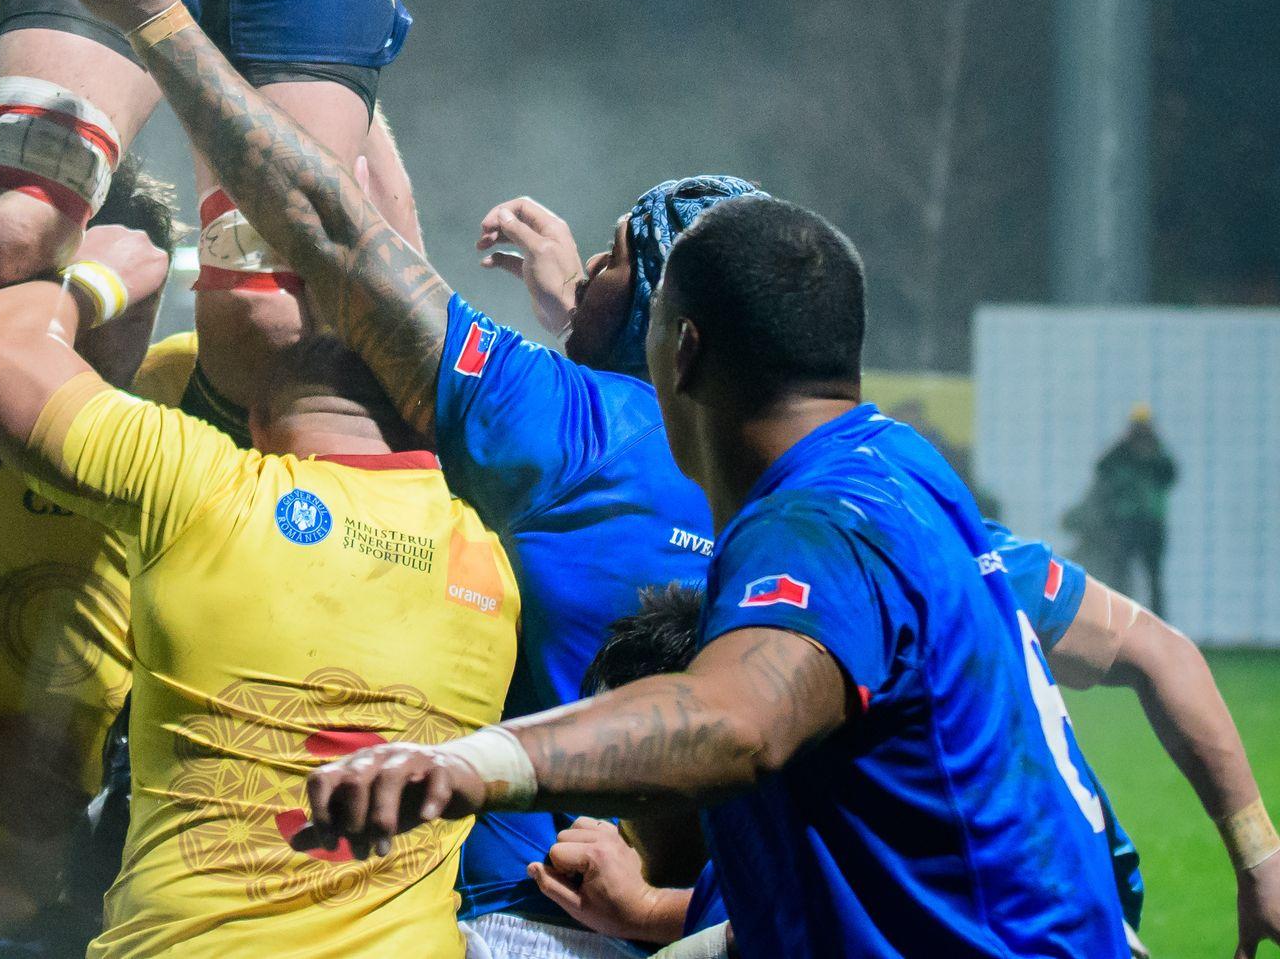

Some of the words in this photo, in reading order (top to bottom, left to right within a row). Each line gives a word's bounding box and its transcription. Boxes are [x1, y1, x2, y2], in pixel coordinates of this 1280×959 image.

[344, 516, 435, 550] MINISTERUL
[669, 527, 715, 557] INVE
[359, 543, 432, 574] SPORTULUI
[448, 584, 497, 612] orange
